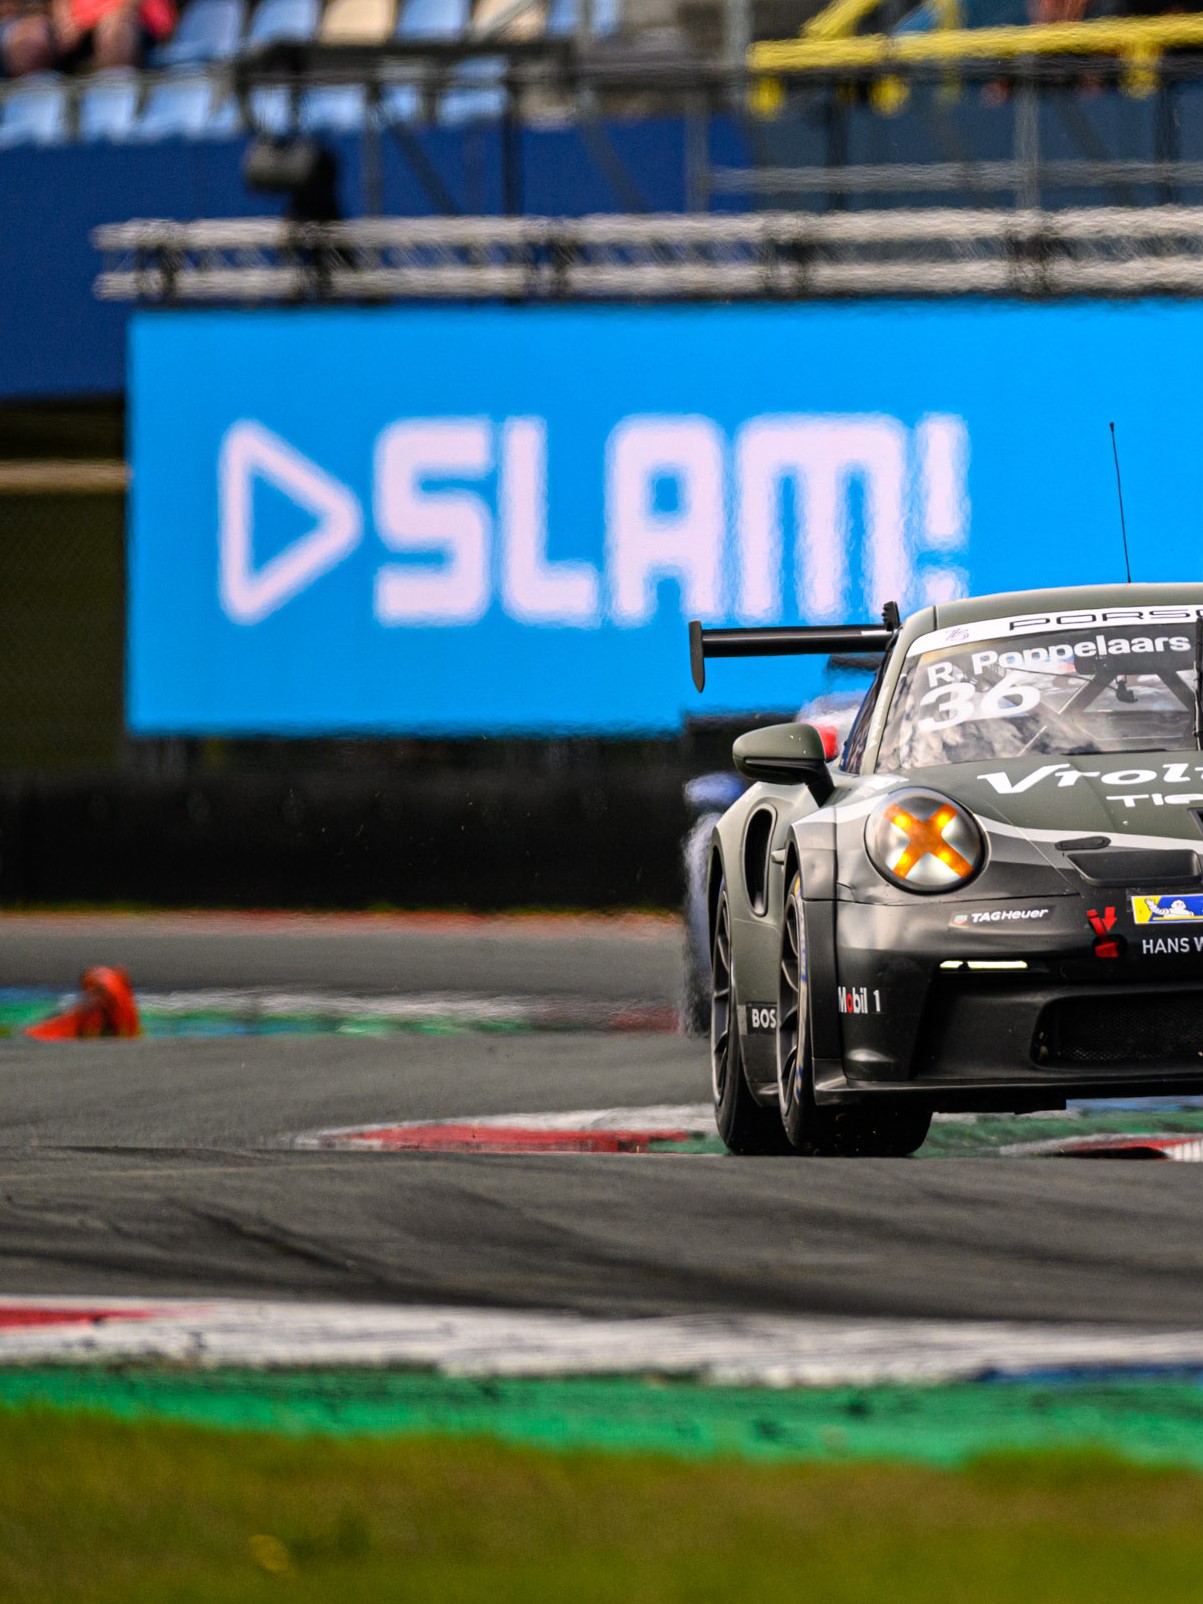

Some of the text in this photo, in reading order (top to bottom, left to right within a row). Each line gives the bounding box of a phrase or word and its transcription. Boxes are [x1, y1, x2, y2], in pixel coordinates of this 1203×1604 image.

[373, 412, 969, 626] SLAM!
[971, 635, 1192, 676] Poppelaars
[918, 675, 1041, 733] 36
[1142, 937, 1190, 954] HANS
[837, 986, 882, 1014] Mobil 1
